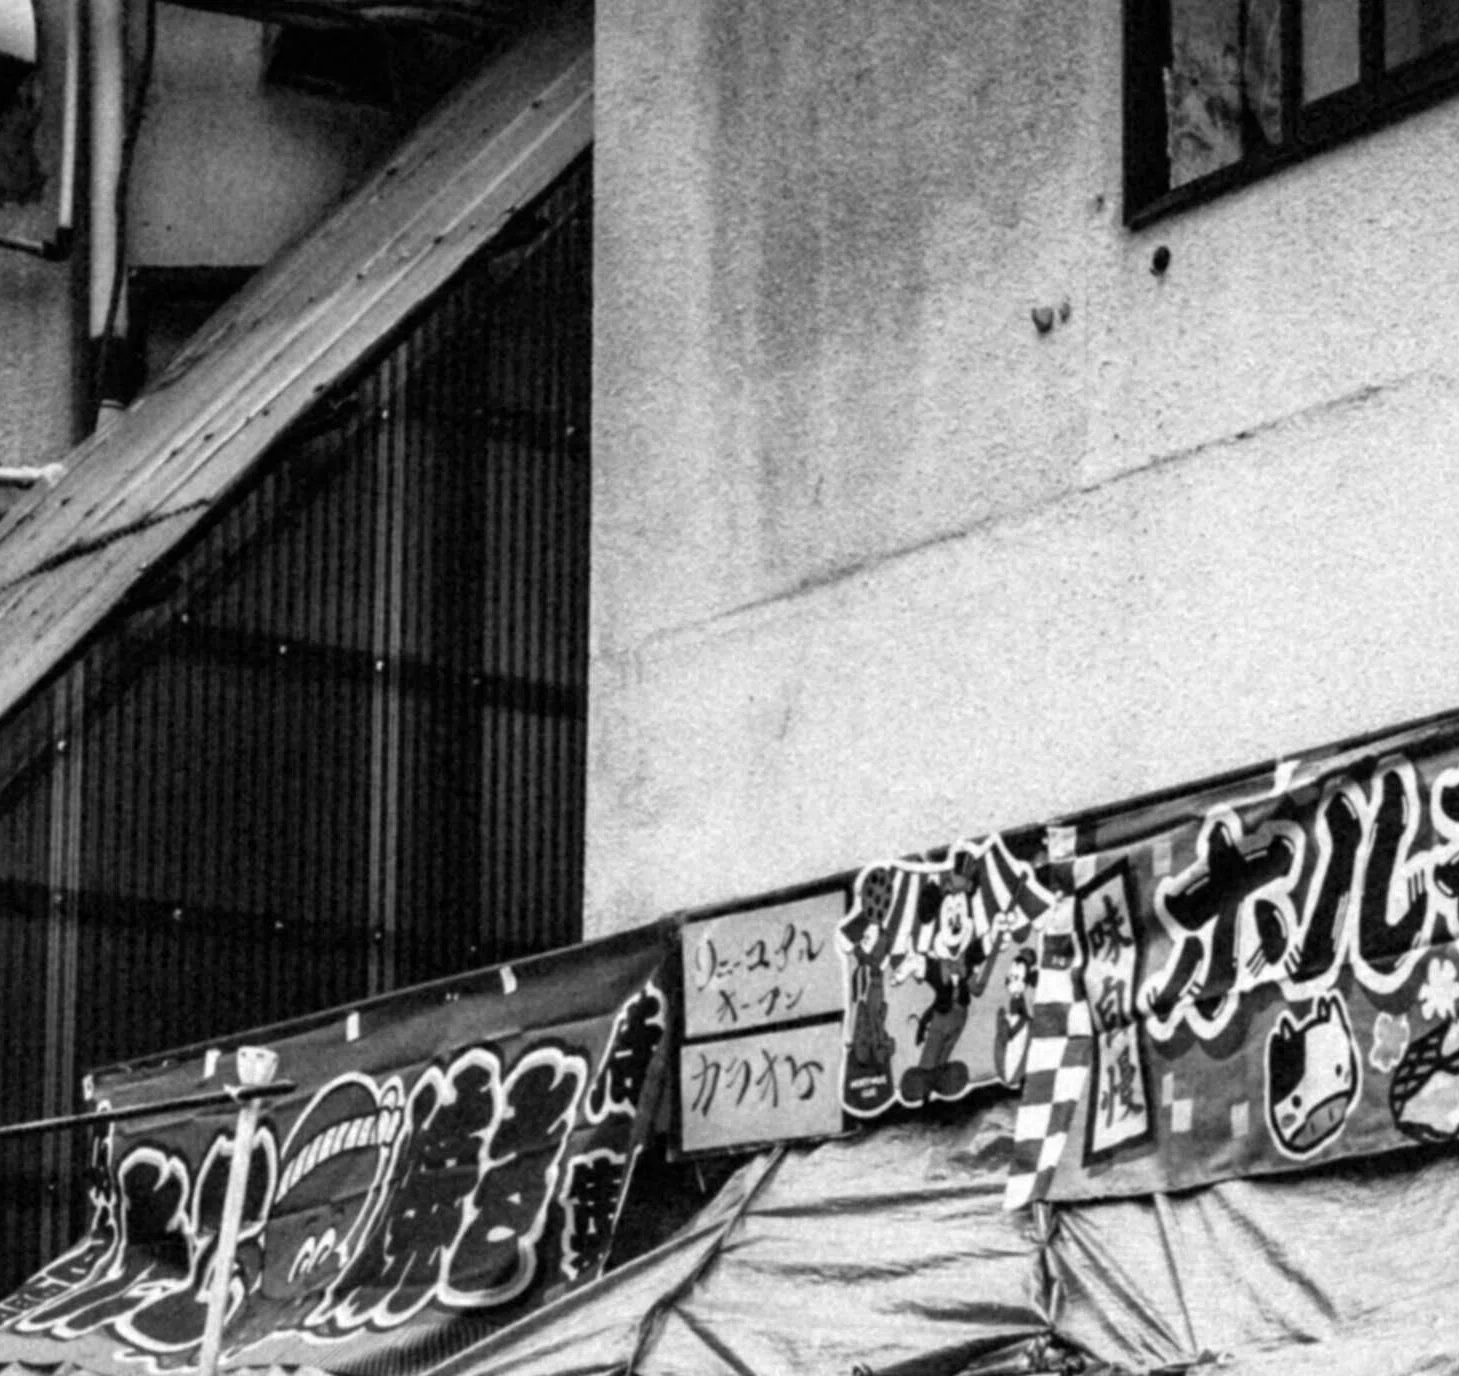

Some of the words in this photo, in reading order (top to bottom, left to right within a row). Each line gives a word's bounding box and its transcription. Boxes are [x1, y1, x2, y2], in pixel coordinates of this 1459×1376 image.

[691, 1048, 824, 1116] カラオケ
[1088, 895, 1143, 1128] 味自慢
